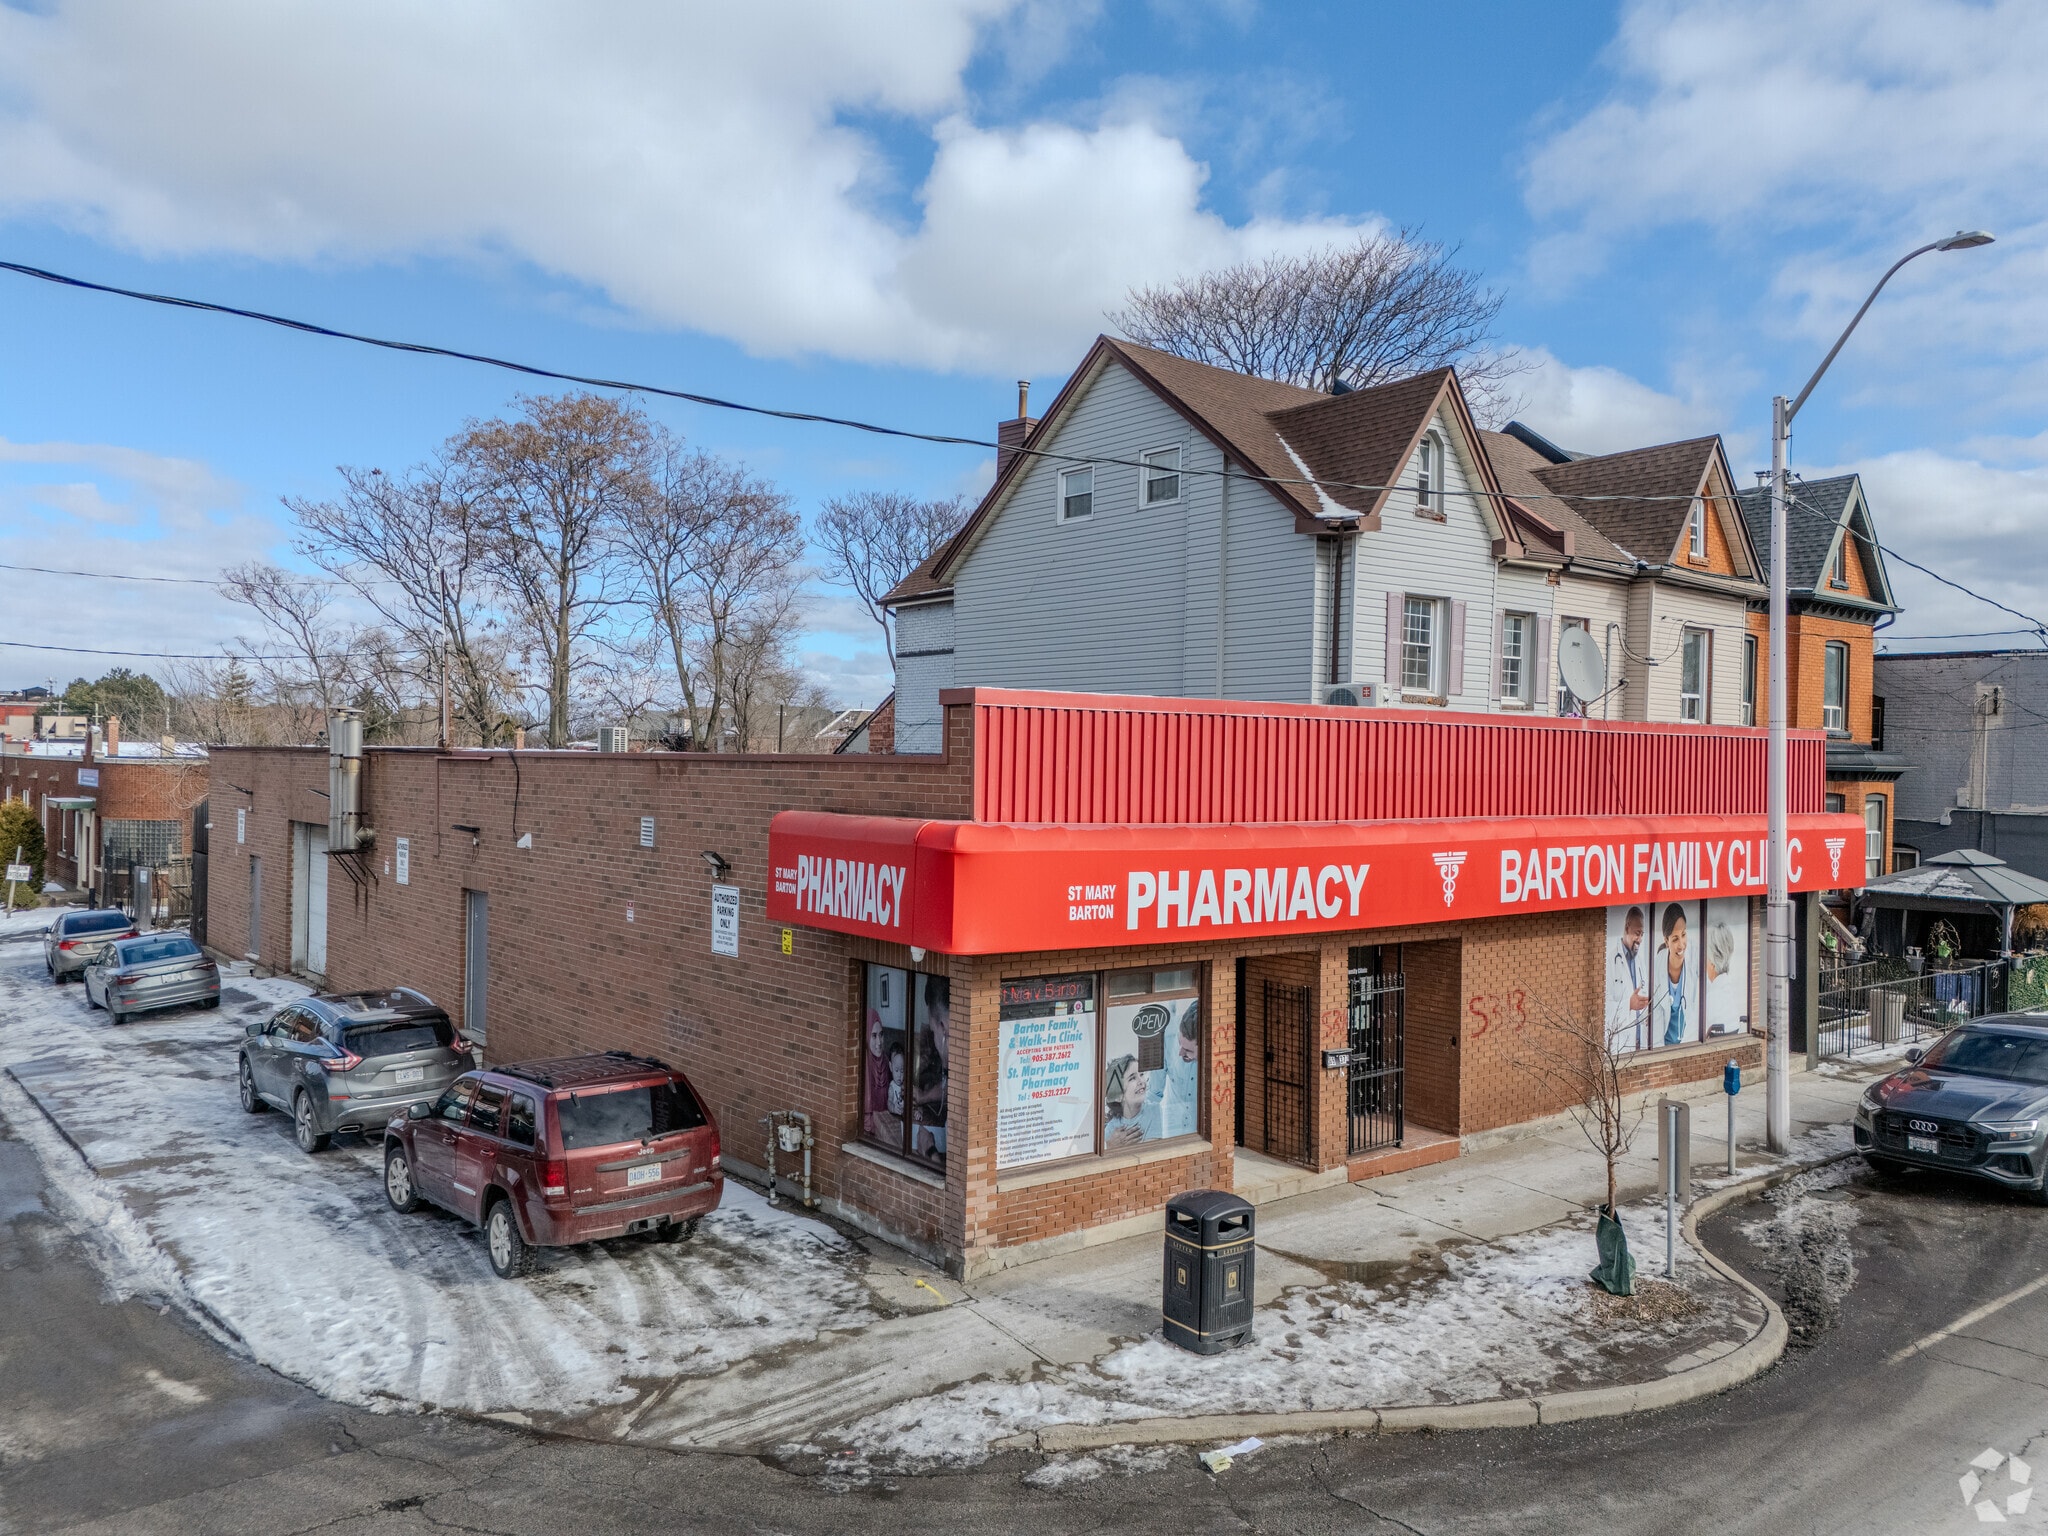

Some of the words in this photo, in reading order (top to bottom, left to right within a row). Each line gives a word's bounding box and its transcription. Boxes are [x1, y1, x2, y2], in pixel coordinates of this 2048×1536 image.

[775, 867, 782, 878] ST
[783, 868, 797, 880] MARY
[1500, 844, 1625, 903] BARTON
[1633, 840, 1725, 895] FAMILY
[1728, 838, 1802, 886] CLIC
[775, 882, 796, 894] BARTON
[796, 855, 906, 927] PHARMACY
[1068, 886, 1082, 901] ST
[1085, 885, 1116, 900] MARY
[714, 893, 738, 905] AUTHORIZED
[1127, 864, 1370, 930] PHARMACY
[717, 905, 734, 917] PARKING
[1069, 904, 1114, 921] BARTON
[720, 918, 730, 929] ONLY
[1014, 1024, 1045, 1035] Barton
[1048, 1017, 1078, 1030] Family
[1133, 1013, 1164, 1031] OPEN
[1009, 1038, 1015, 1049] &
[1020, 1033, 1056, 1047] Walk-In
[1059, 1029, 1082, 1043] Clinic
[1032, 1051, 1071, 1062] 905.387.2612
[1008, 1068, 1018, 1079] St.
[1022, 1065, 1046, 1077] Mary
[1049, 1062, 1079, 1073] Barton
[1022, 1076, 1068, 1090] Pharmacy
[1032, 1088, 1070, 1099] 905.521.2227
[637, 1147, 655, 1156] Jeep
